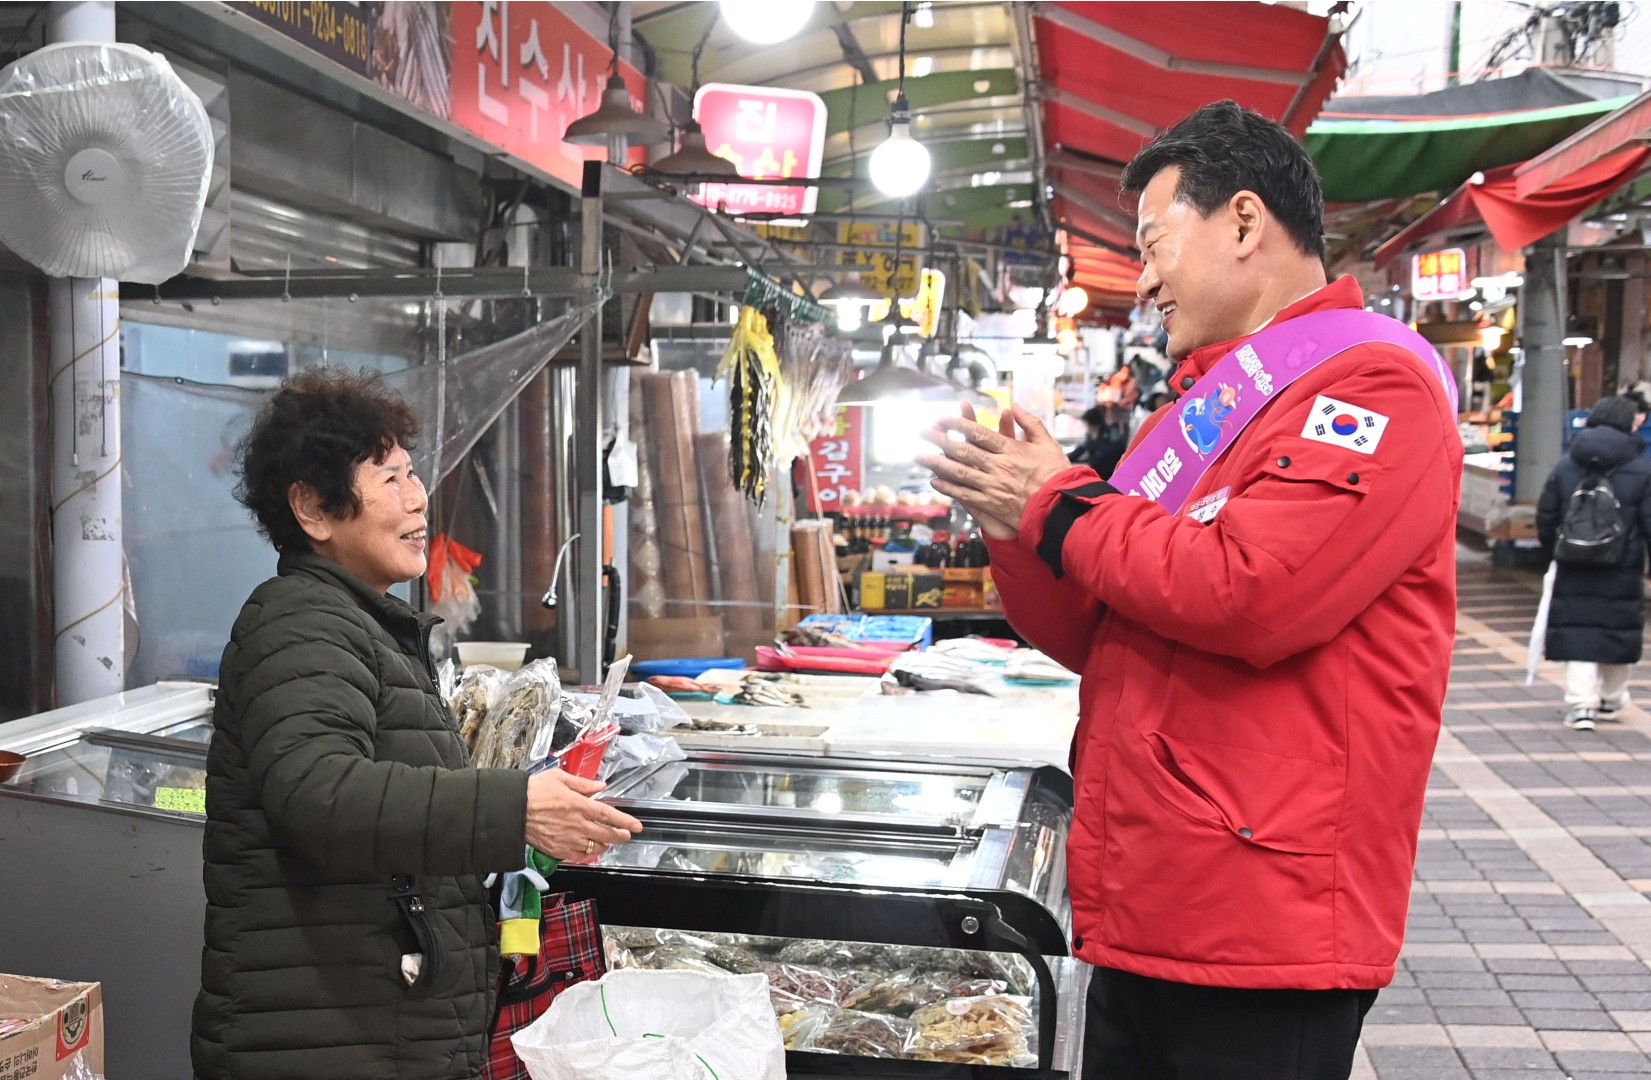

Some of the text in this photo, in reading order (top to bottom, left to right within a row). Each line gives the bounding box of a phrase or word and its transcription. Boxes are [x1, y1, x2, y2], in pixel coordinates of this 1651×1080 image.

[475, 1, 608, 165] 진수산
[1128, 447, 1184, 502] 행복
[13, 1046, 39, 1068] 어머니의
